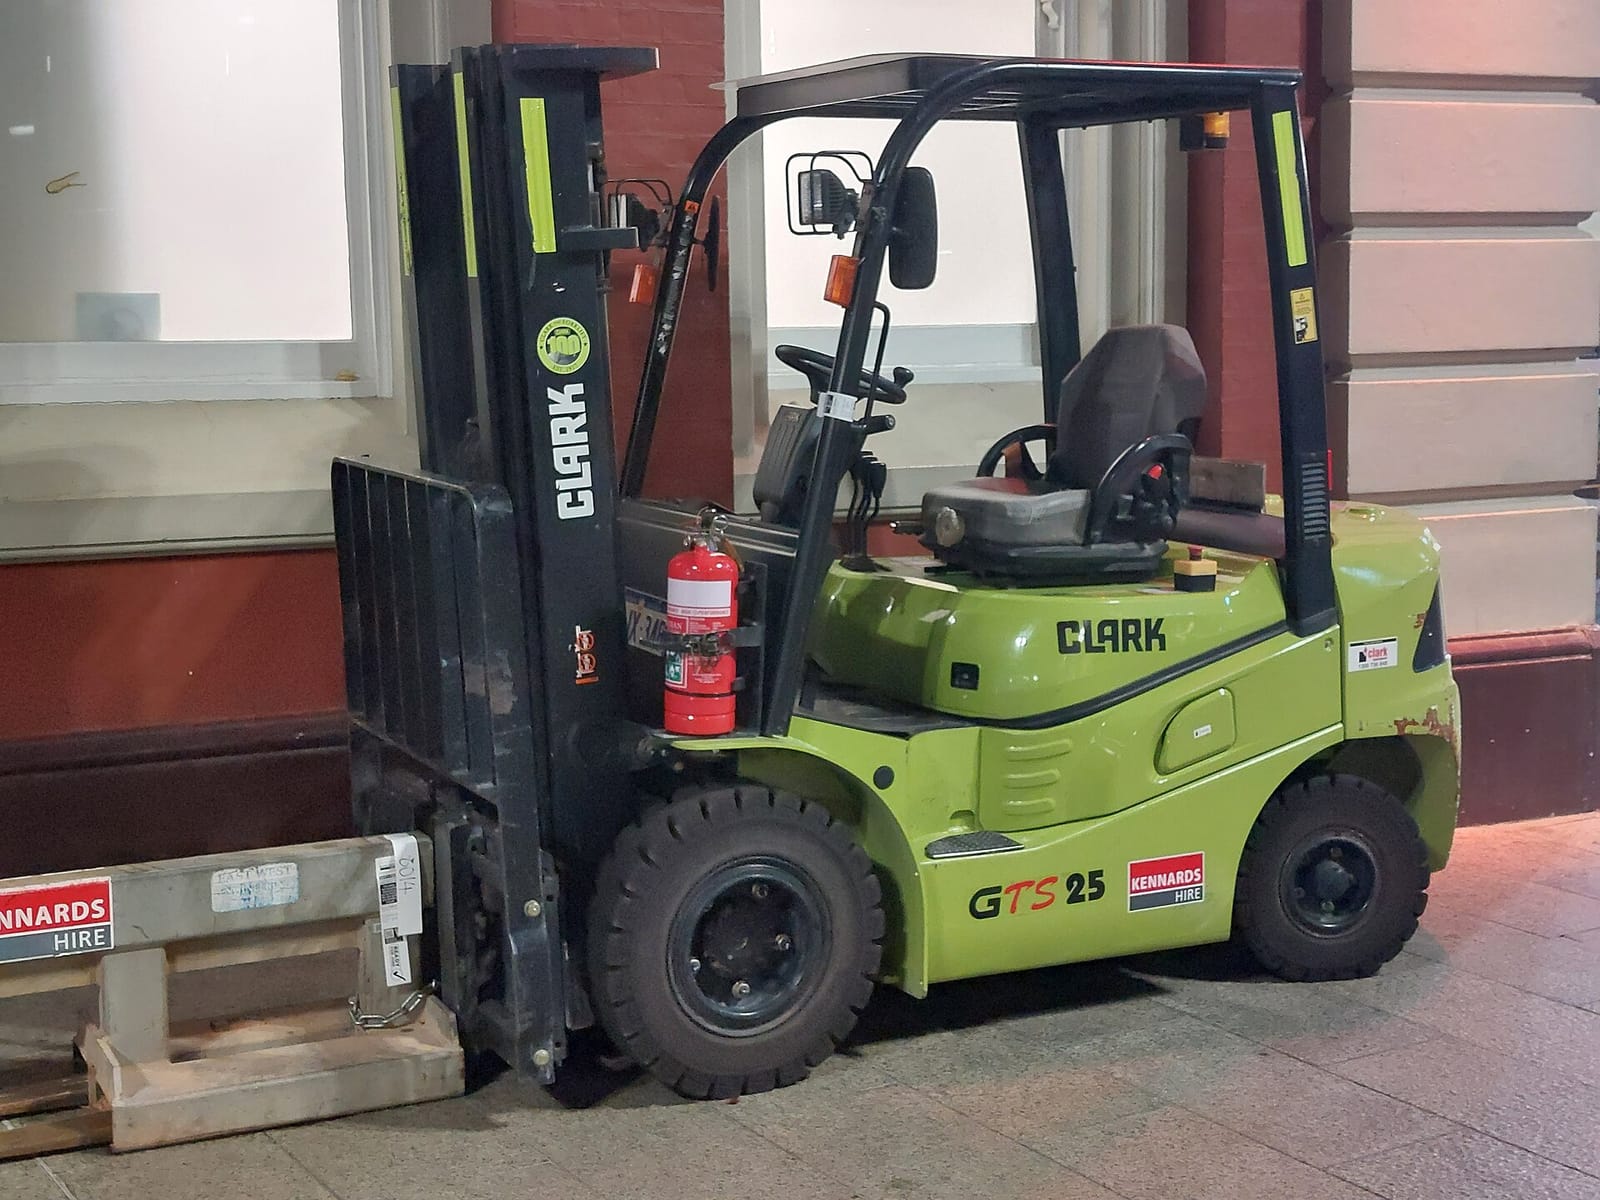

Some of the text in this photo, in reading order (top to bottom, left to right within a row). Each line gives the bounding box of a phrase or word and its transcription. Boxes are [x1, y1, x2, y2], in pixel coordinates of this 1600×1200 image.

[547, 383, 594, 519] CLARK
[1056, 618, 1166, 654] CLARK
[969, 869, 1106, 920] GTS 25
[1131, 868, 1201, 891] KENNARDS
[1175, 887, 1201, 903] HIRE
[0, 898, 106, 930] NNARDS
[54, 928, 106, 951] HIRE
